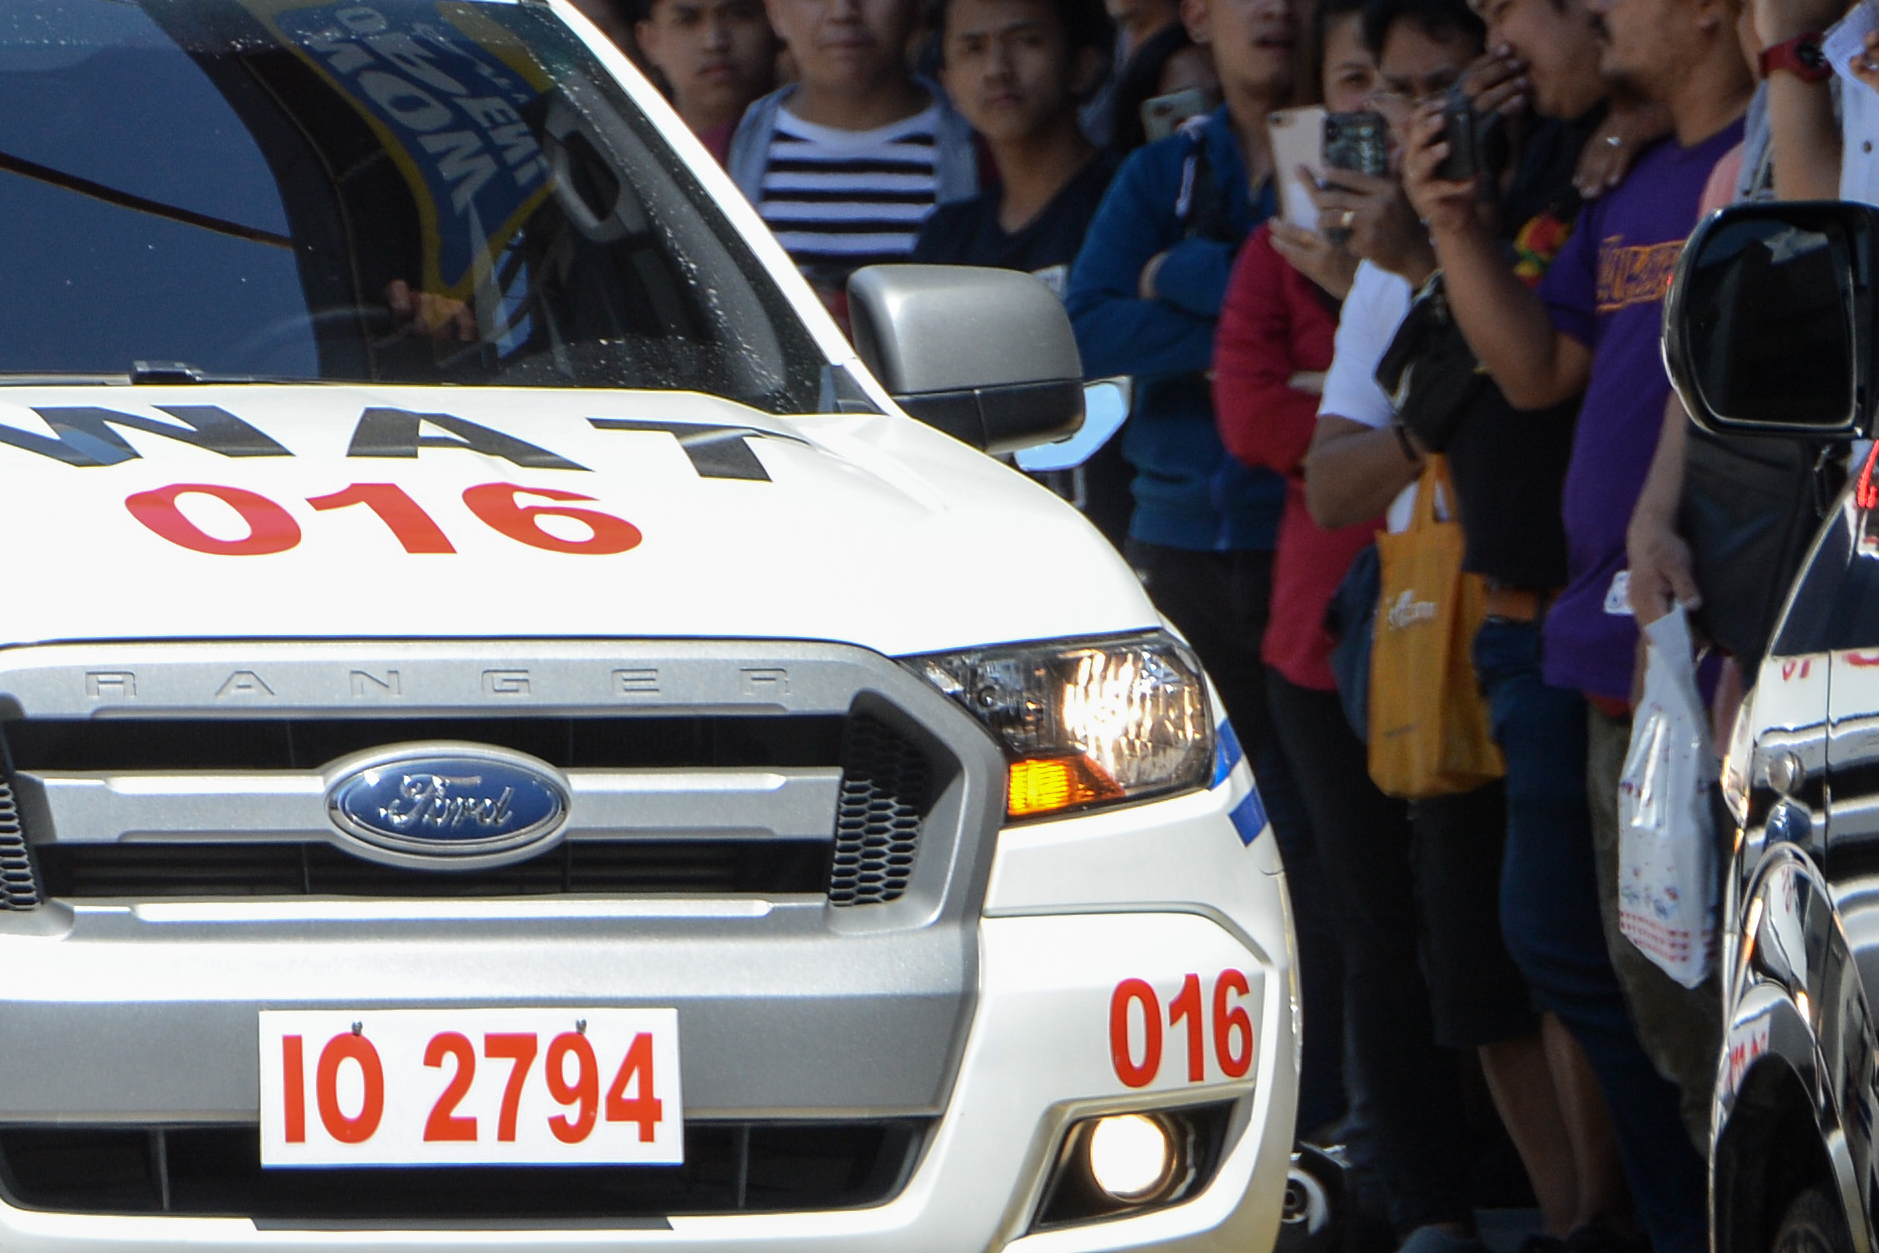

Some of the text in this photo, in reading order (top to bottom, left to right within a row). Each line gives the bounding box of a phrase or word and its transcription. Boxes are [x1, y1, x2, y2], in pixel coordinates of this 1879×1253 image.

[124, 481, 644, 556] 016
[84, 665, 795, 703] RANGER
[379, 774, 514, 828] Ford
[1109, 969, 1254, 1089] 016
[423, 1030, 662, 1144] 2794
